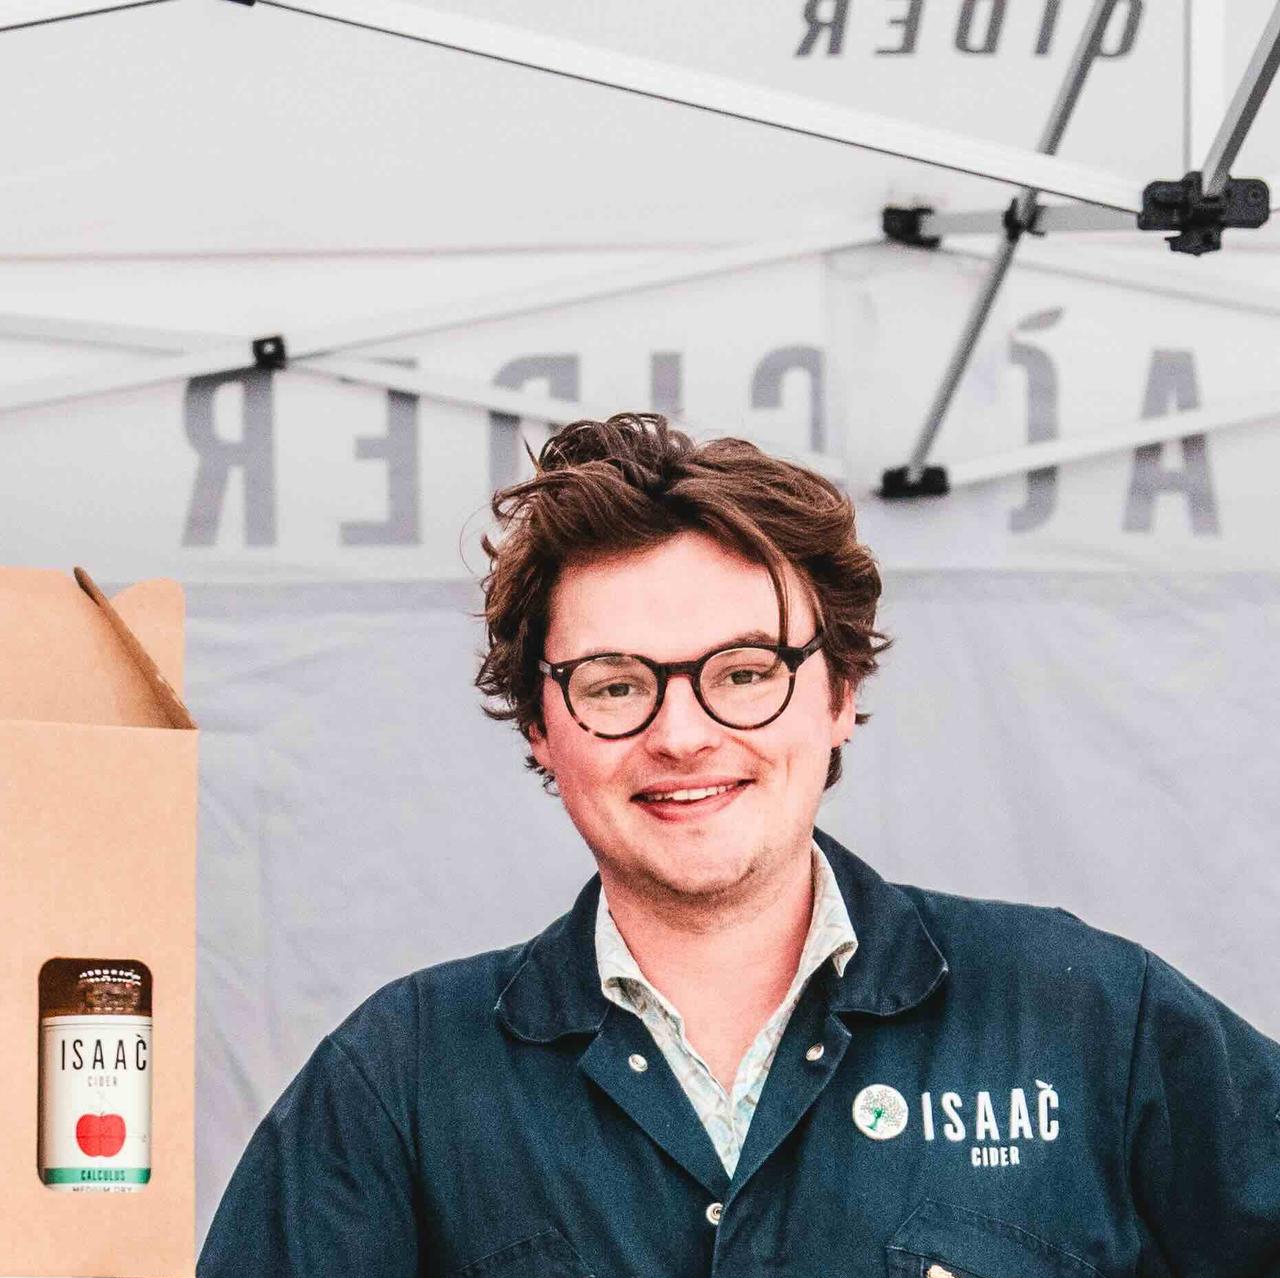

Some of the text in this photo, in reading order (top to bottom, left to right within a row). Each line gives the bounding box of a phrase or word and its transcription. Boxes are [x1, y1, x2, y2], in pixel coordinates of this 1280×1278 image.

[921, 1080, 1060, 1141] ISAAC
[970, 1146, 1020, 1167] CIDER
[80, 1170, 127, 1181] CALCULUS
